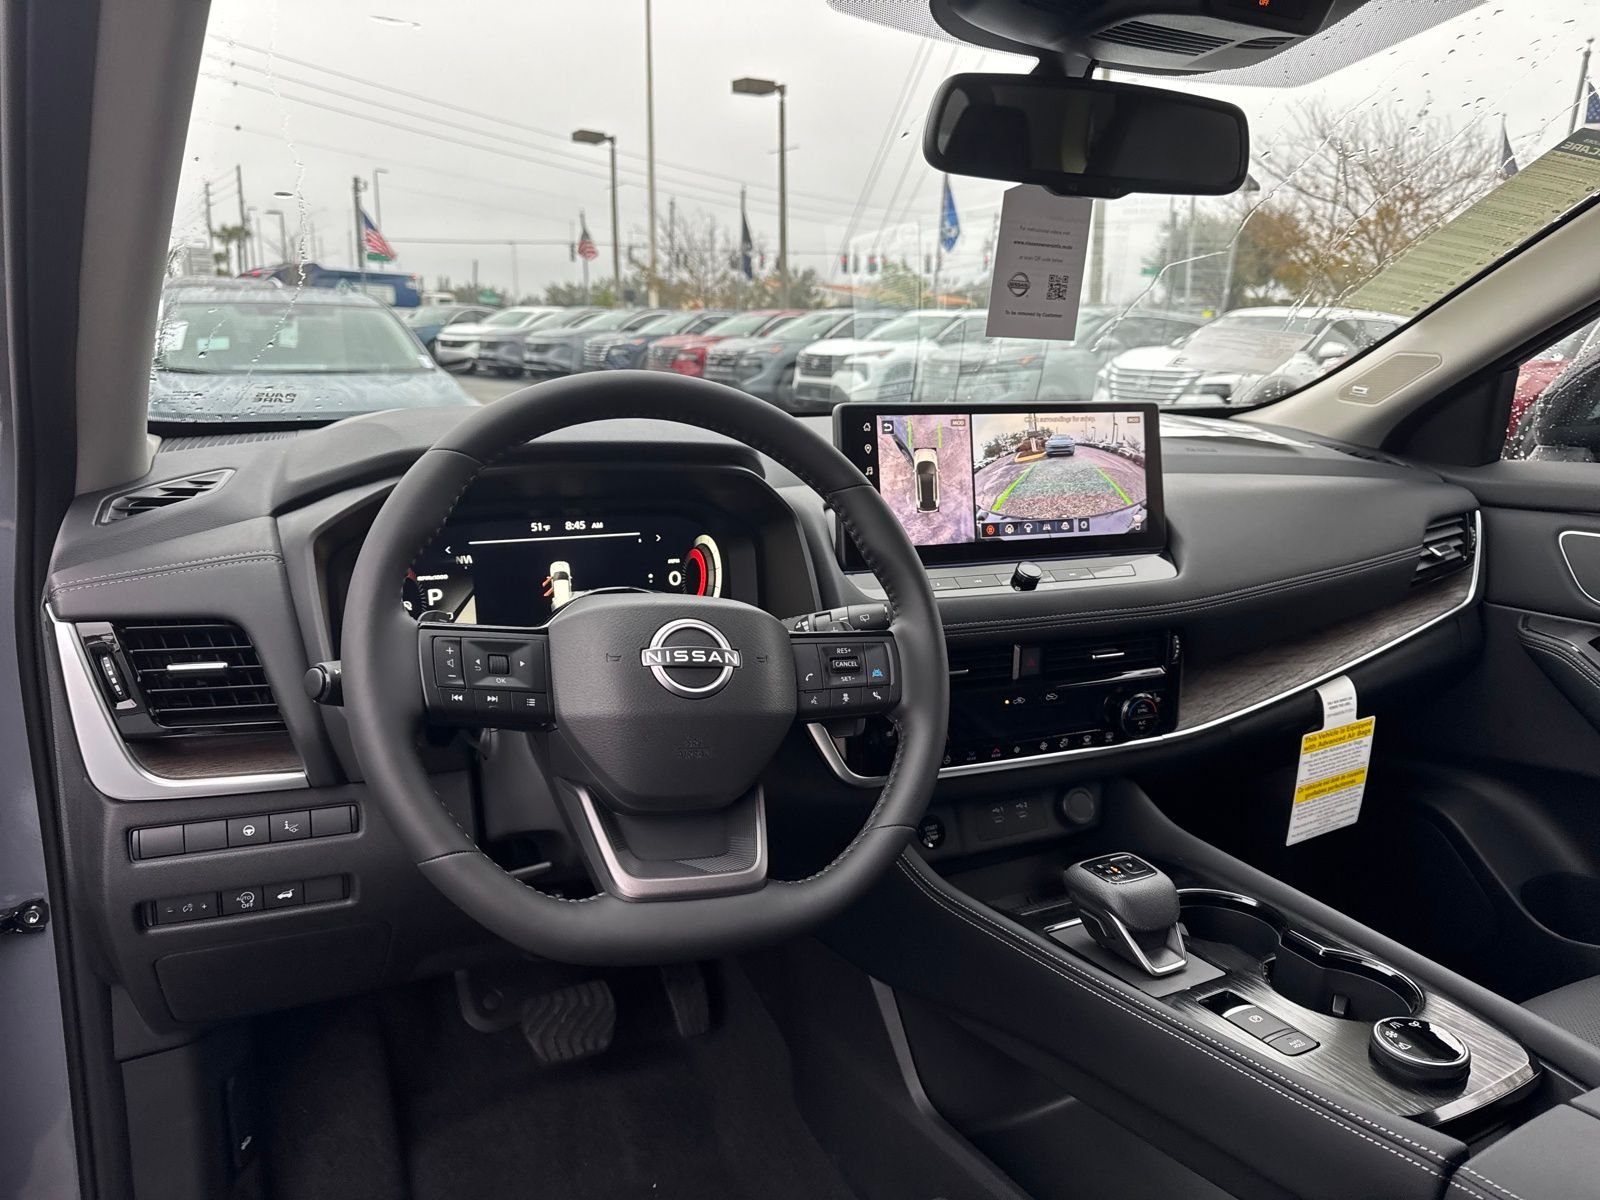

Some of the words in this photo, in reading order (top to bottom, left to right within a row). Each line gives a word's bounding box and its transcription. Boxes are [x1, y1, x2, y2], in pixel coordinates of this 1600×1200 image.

[564, 520, 586, 531] 8:45
[427, 588, 443, 606] P
[644, 651, 738, 665] NISSAN
[834, 660, 858, 668] CANCEL
